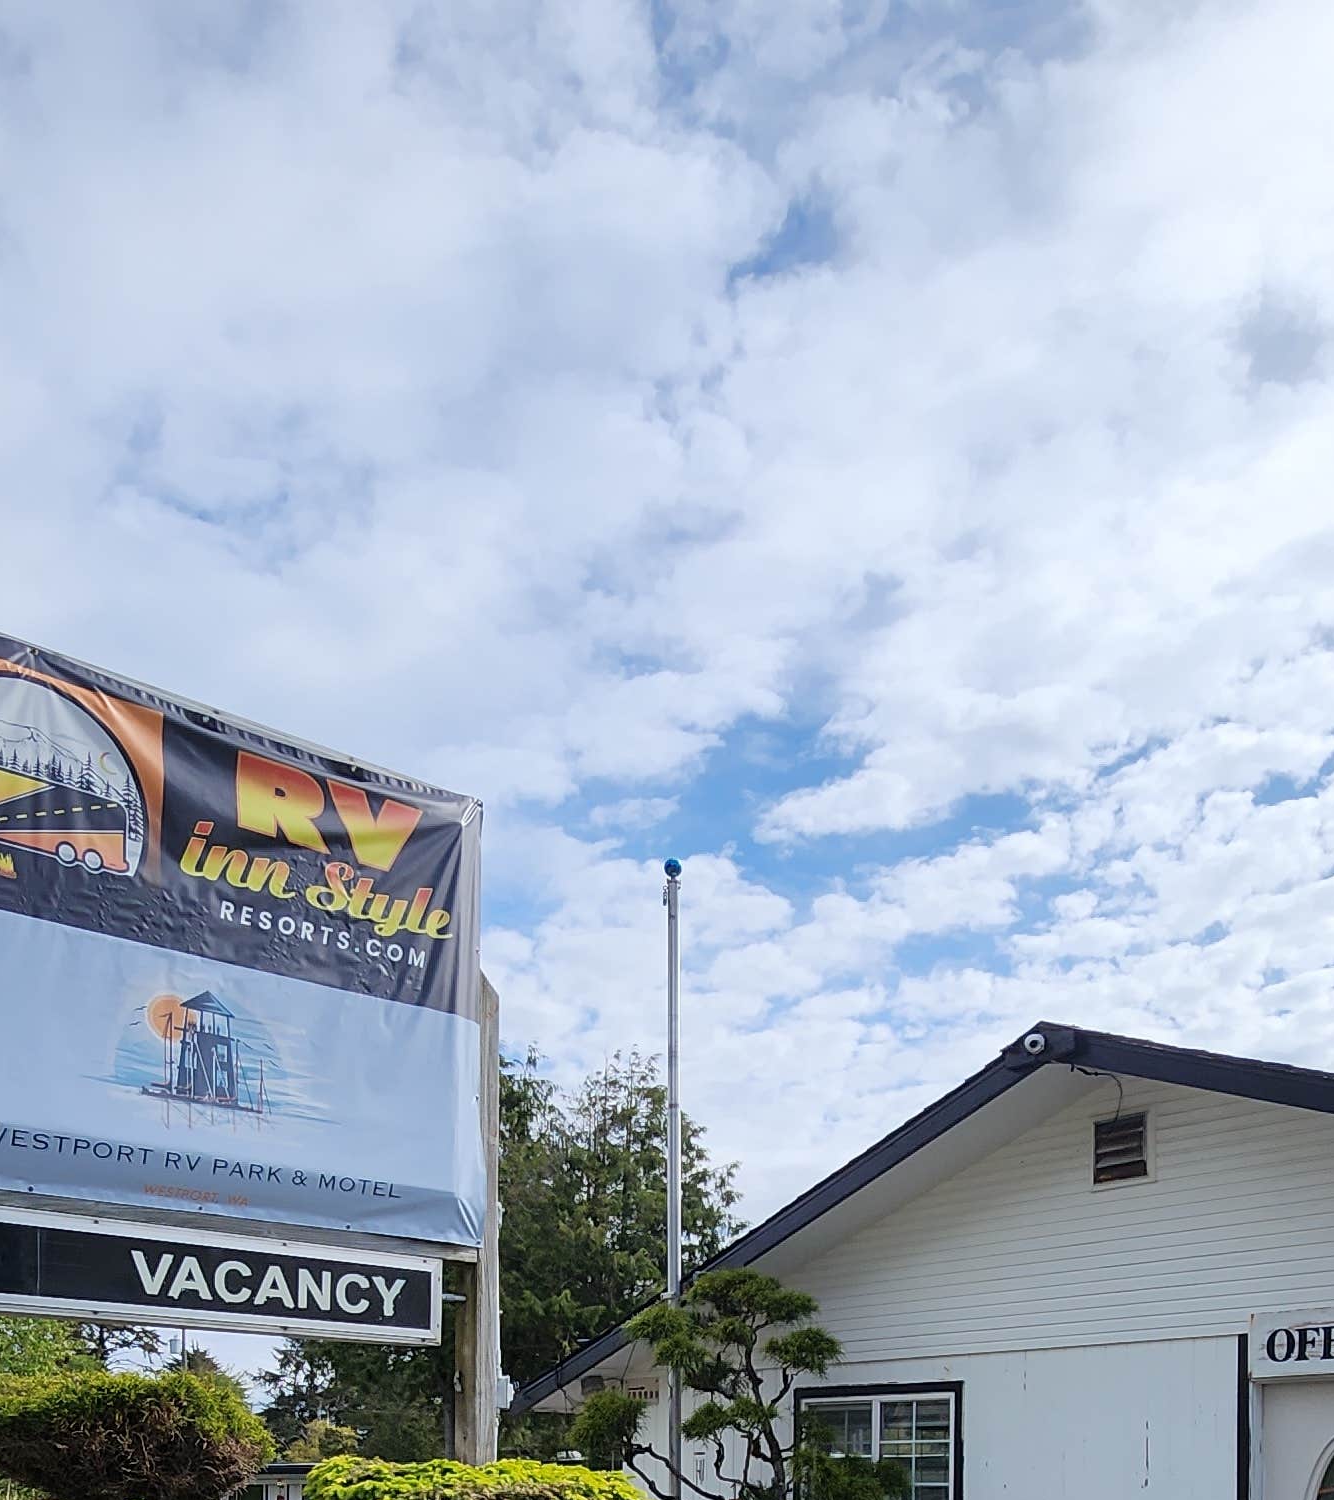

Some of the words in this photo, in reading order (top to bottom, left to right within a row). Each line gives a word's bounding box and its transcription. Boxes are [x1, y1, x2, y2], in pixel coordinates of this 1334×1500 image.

[236, 749, 423, 873] RV
[179, 820, 297, 900] inn
[305, 860, 454, 940] Style
[219, 900, 427, 969] RESORTS.COM
[164, 1151, 203, 1173] RV
[212, 1157, 283, 1185] PARK
[291, 1167, 309, 1187] &
[319, 1173, 403, 1200] MOTEL
[130, 1249, 408, 1318] VACANCY
